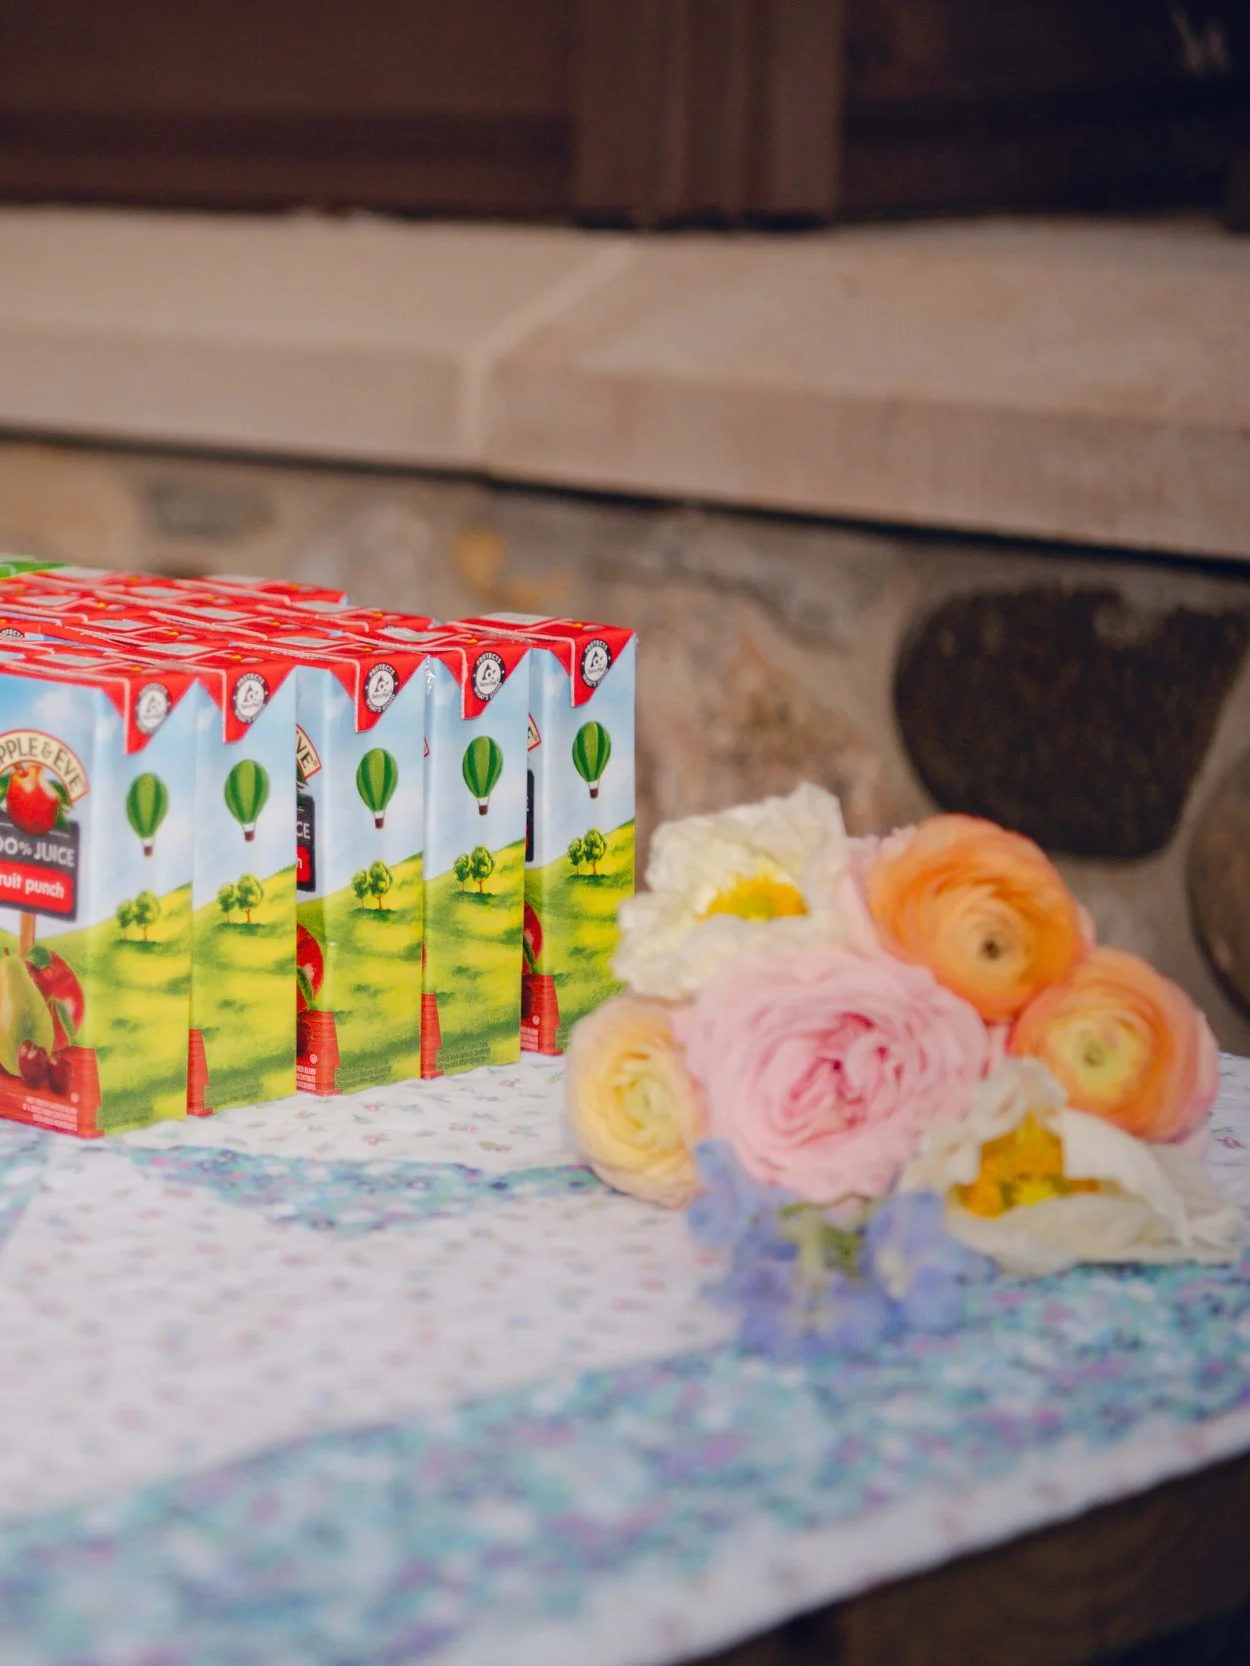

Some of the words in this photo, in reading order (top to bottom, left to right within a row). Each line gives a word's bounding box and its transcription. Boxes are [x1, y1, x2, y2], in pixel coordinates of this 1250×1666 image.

[584, 640, 608, 653] PROTECTS
[476, 652, 501, 665] PROTECTS
[369, 663, 395, 677] PROTECTS
[41, 741, 53, 759] &
[53, 748, 82, 793] EVE
[34, 842, 75, 868] JUICE
[25, 878, 65, 899] punch
